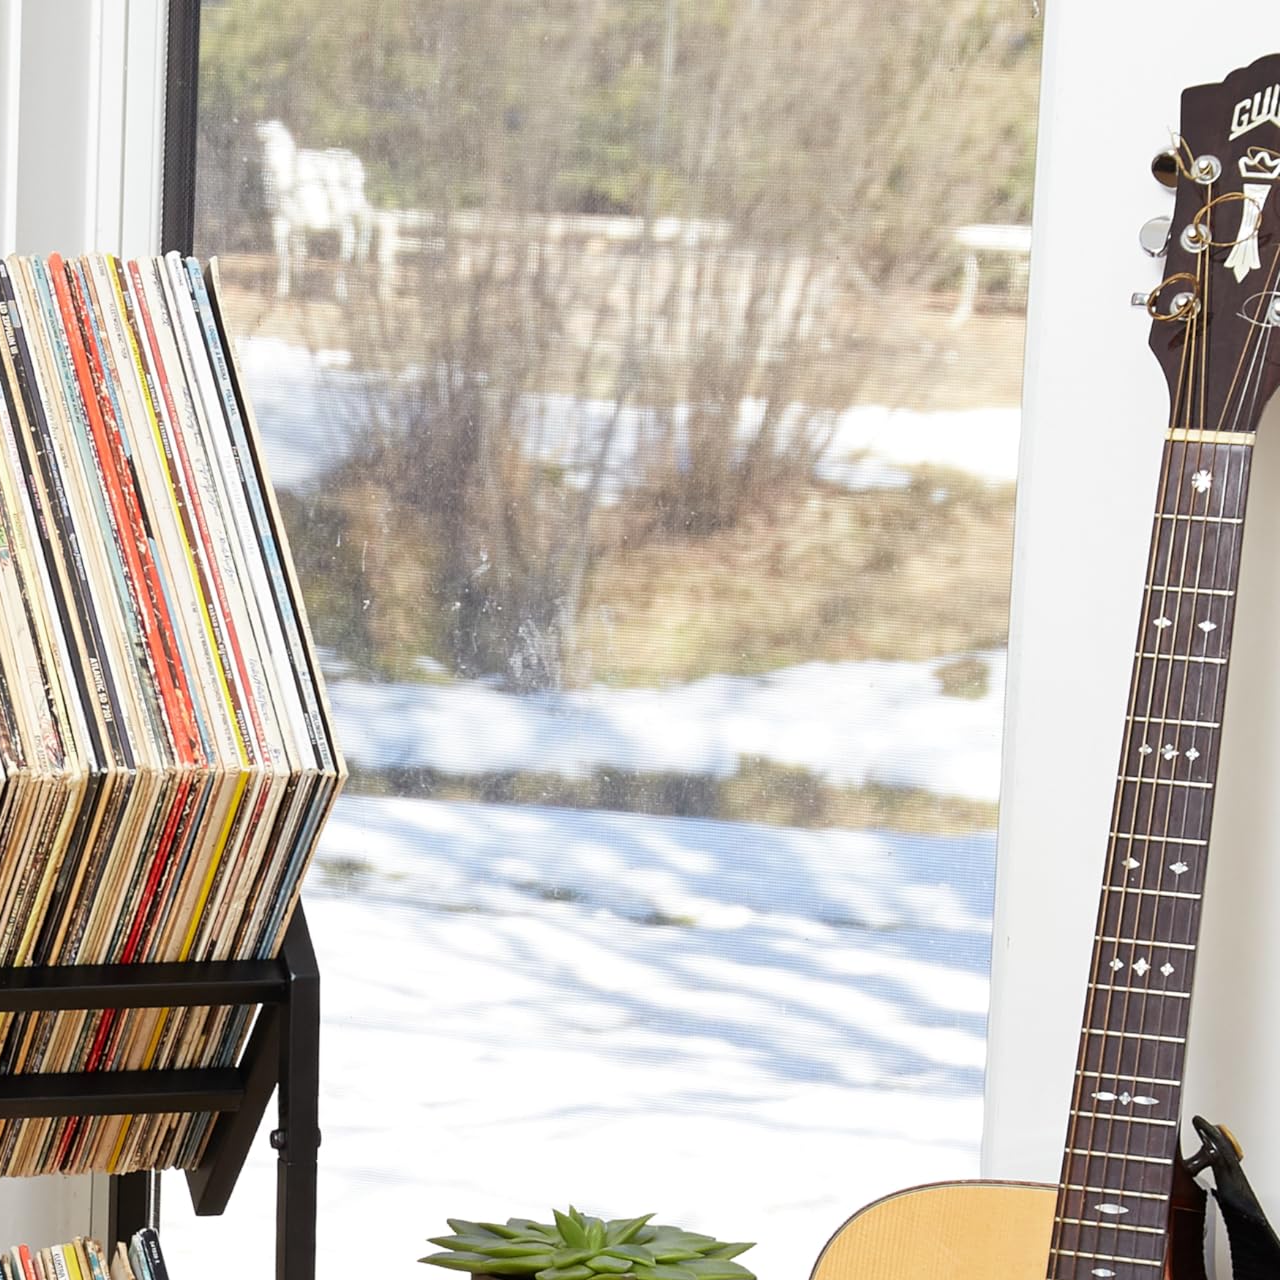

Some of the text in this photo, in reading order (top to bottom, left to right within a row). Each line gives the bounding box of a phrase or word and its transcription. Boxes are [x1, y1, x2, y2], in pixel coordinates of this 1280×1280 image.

[1229, 83, 1280, 141] GUI
[2, 314, 15, 345] ZEPPELIN
[89, 657, 112, 721] ATLANTIC SD 7201
